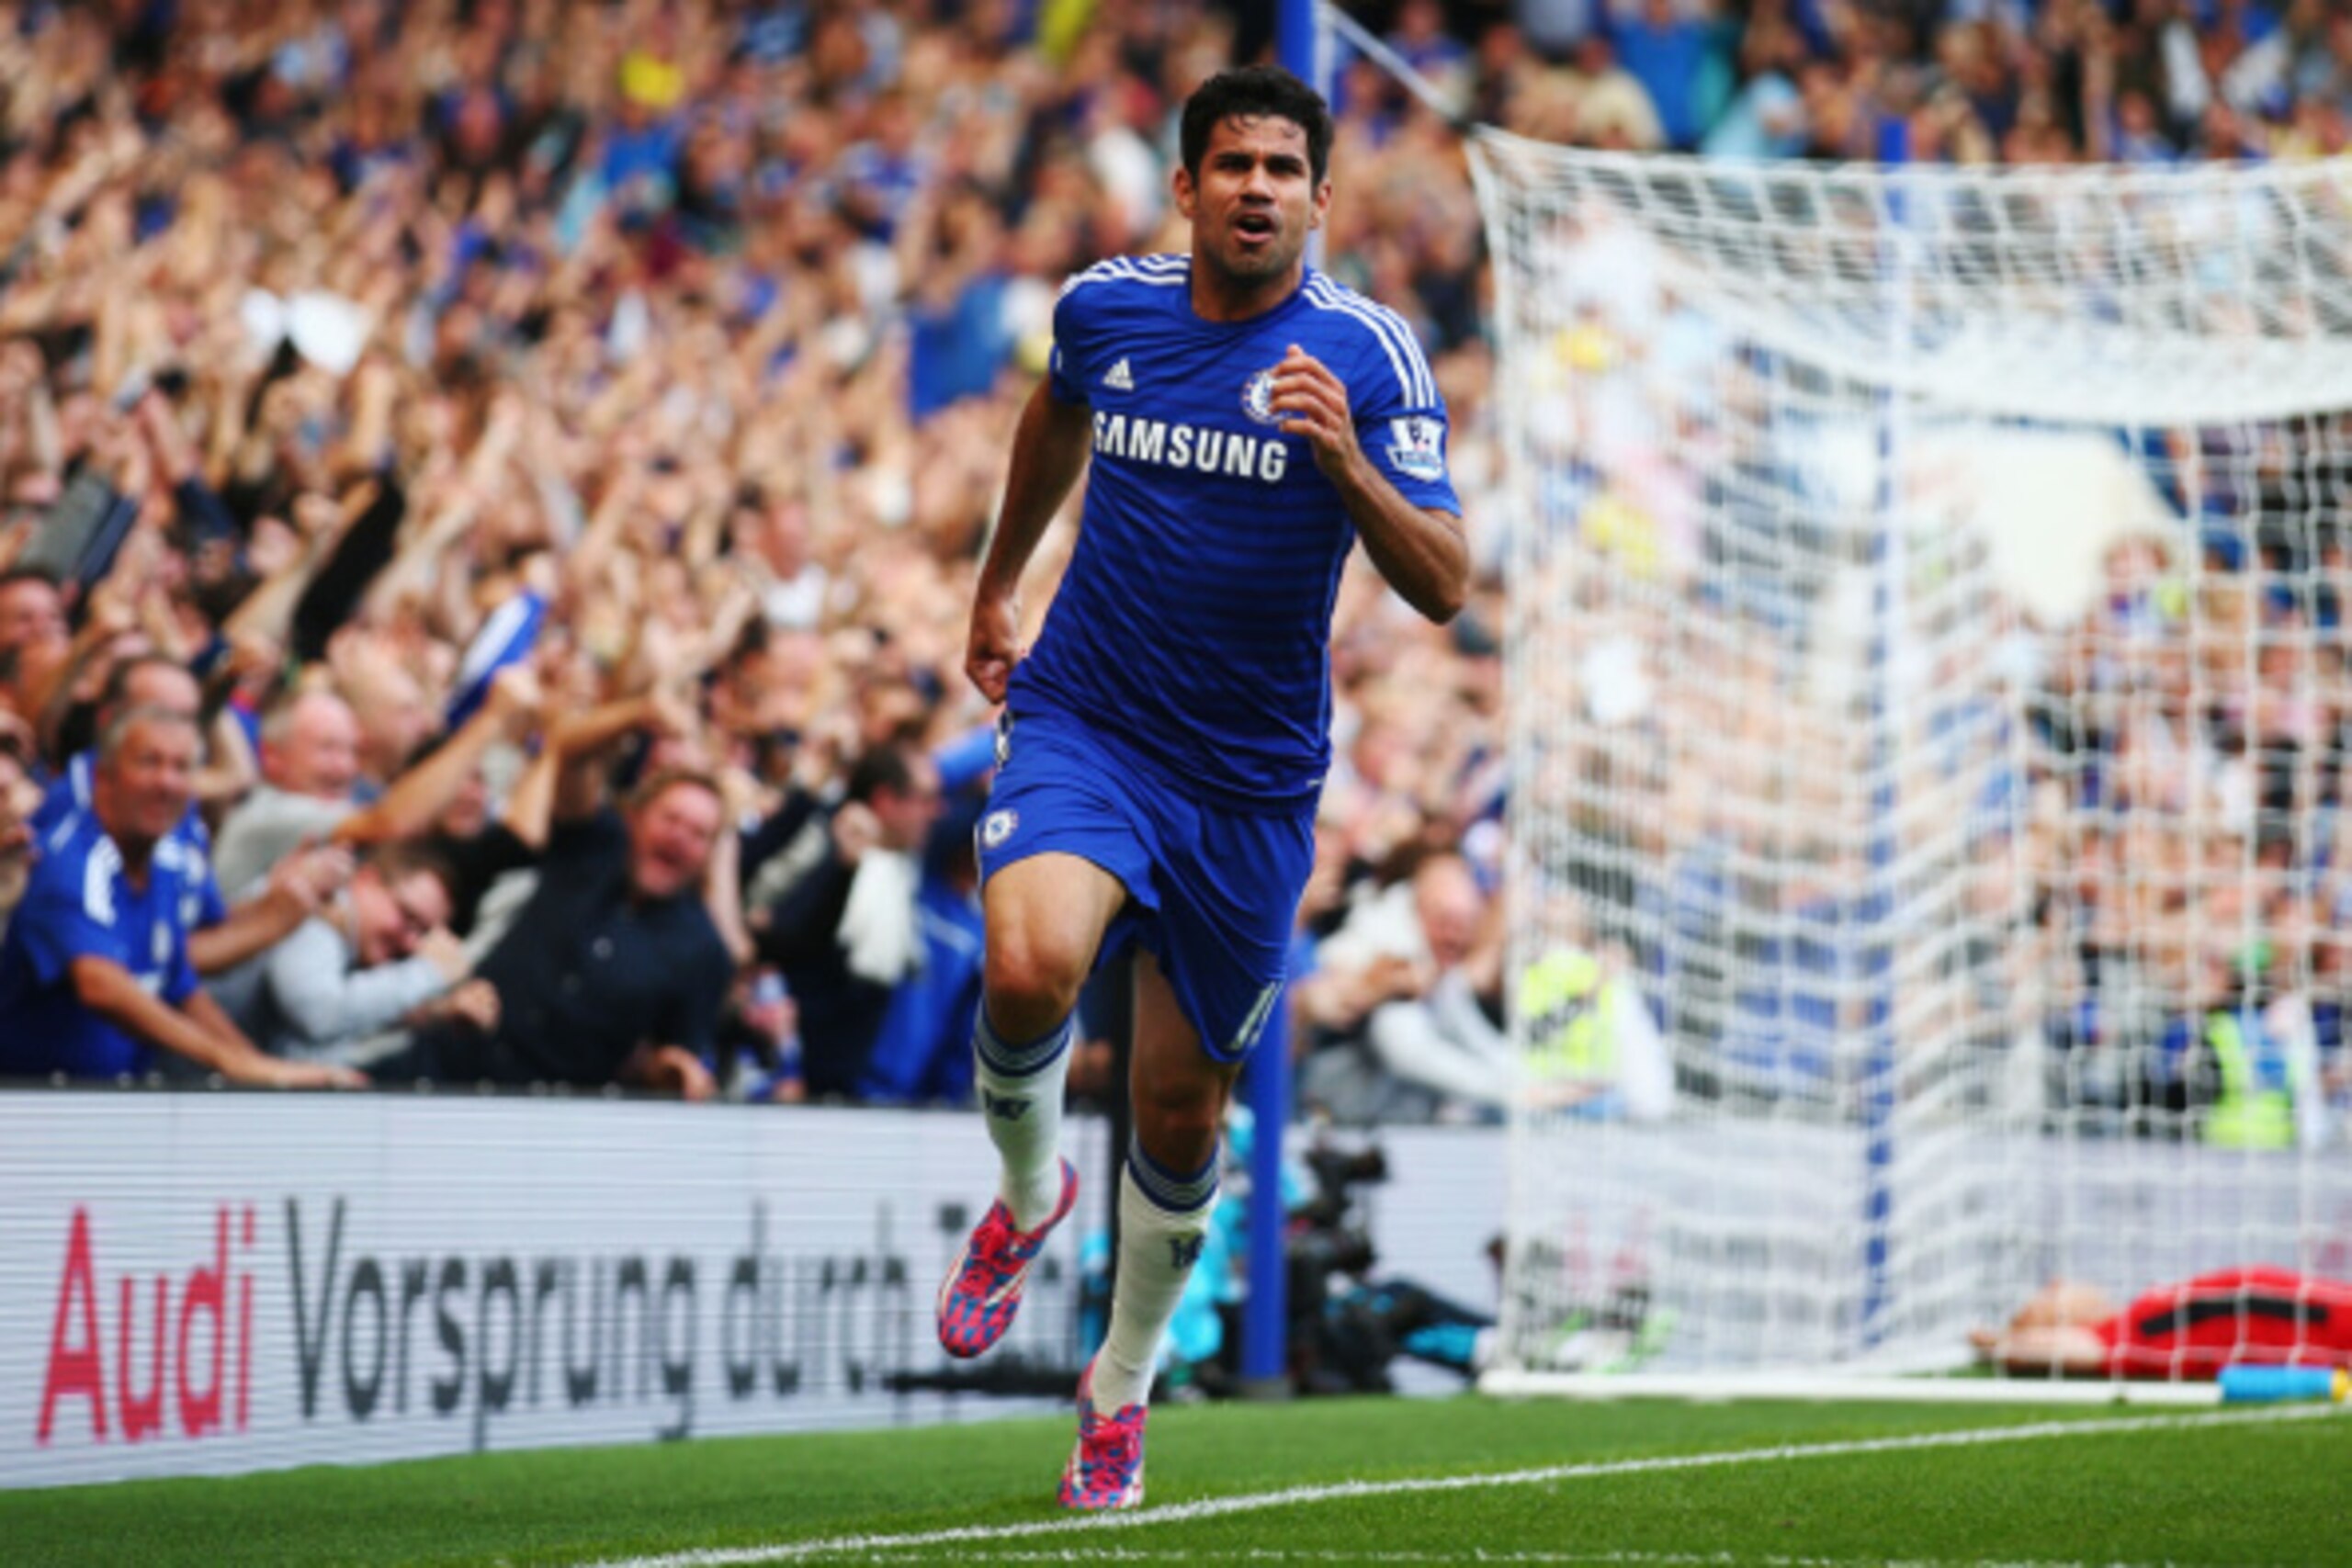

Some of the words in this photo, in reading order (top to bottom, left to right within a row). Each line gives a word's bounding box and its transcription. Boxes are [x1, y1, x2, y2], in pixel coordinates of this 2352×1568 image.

[1093, 411, 1287, 482] SAMSUNG
[35, 1201, 257, 1445] Audi
[284, 1194, 695, 1453] Vorsprung
[722, 1199, 911, 1422] durch
